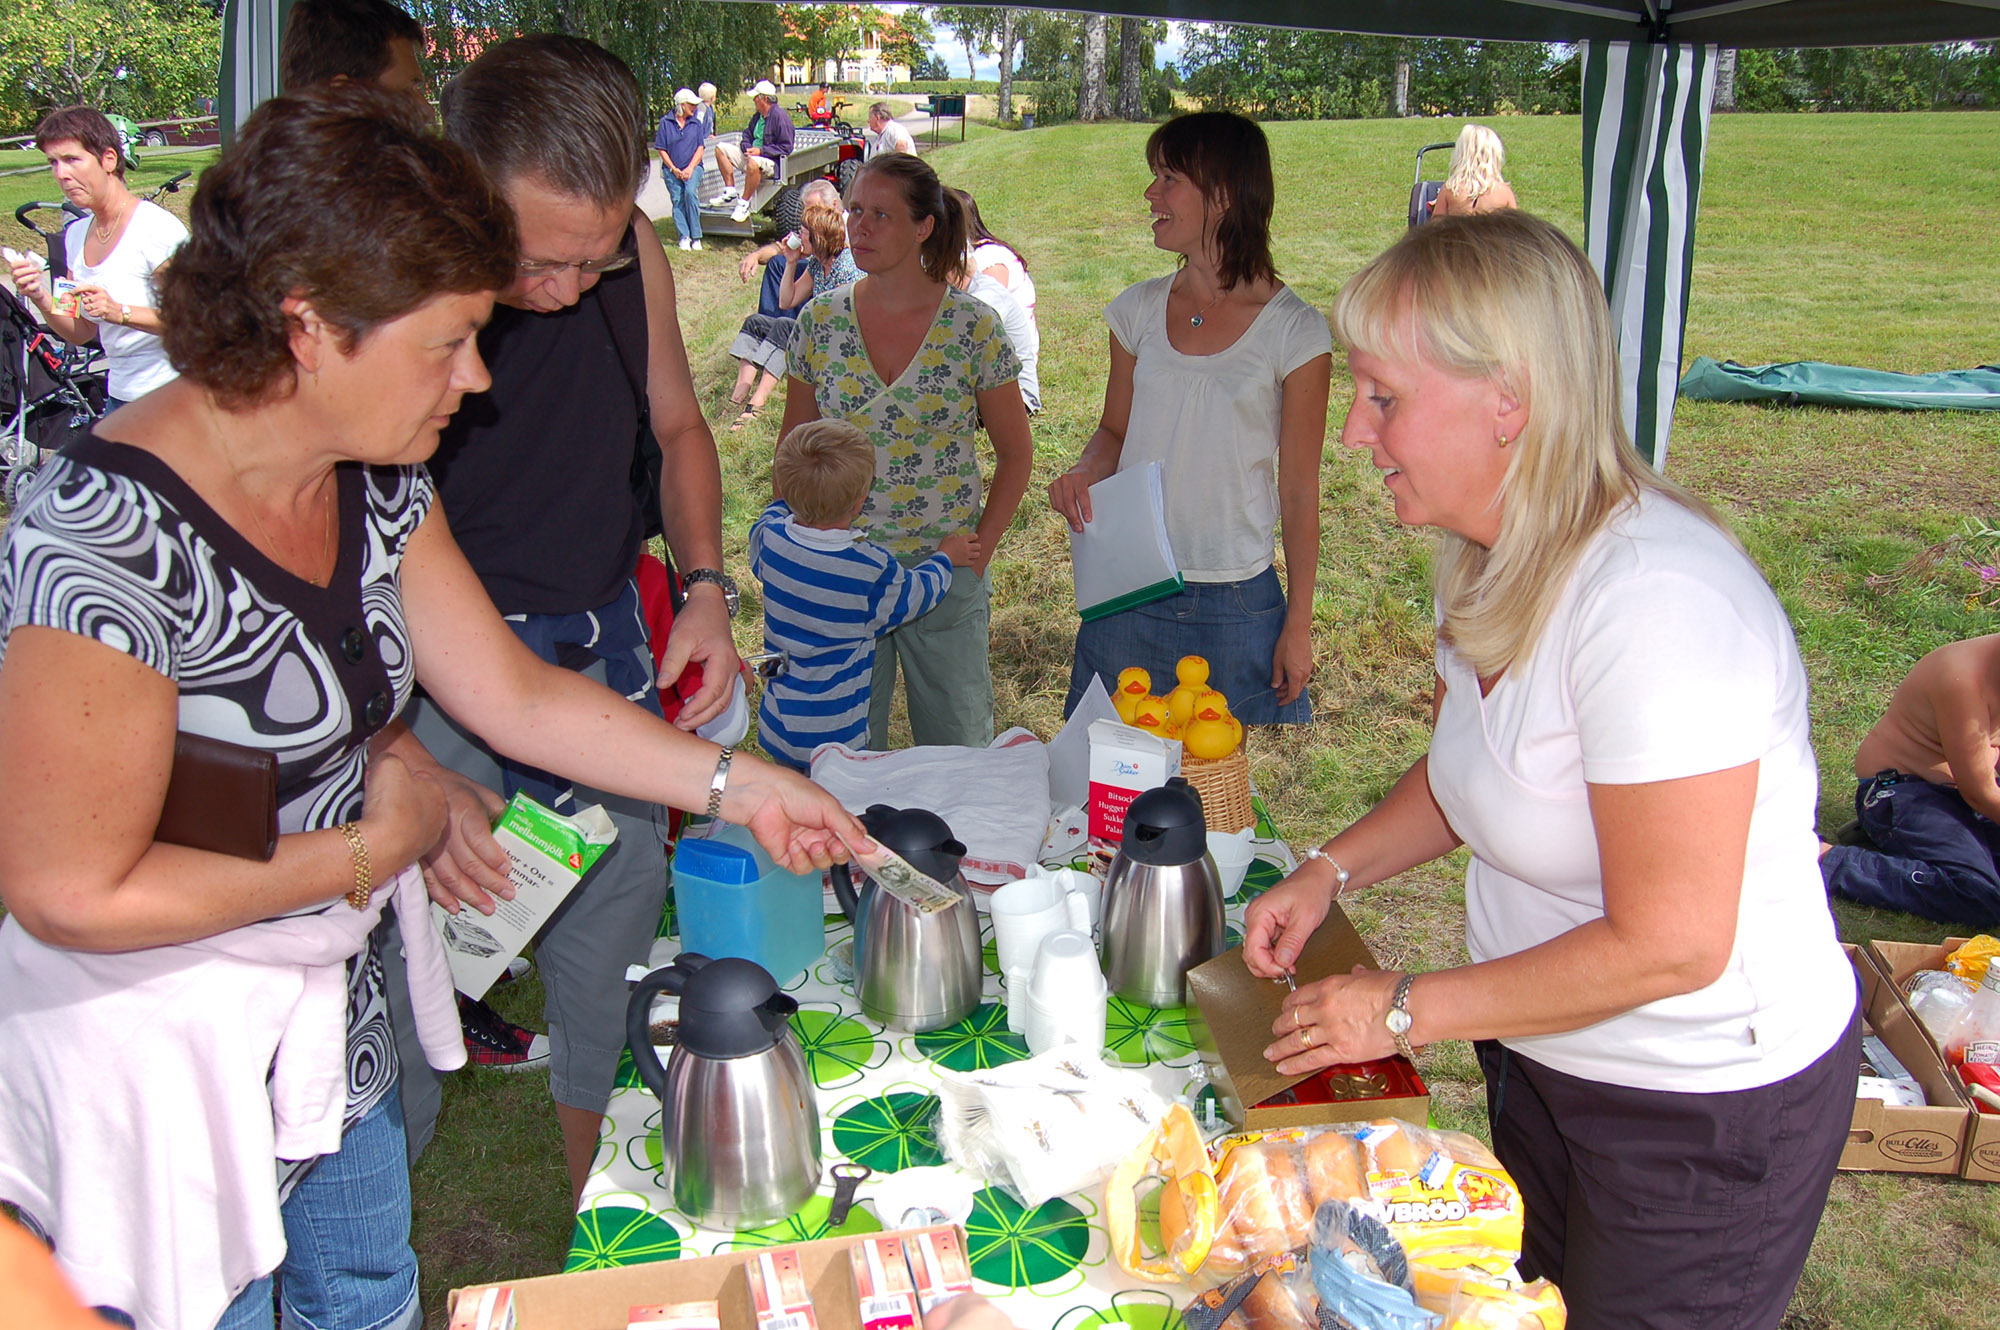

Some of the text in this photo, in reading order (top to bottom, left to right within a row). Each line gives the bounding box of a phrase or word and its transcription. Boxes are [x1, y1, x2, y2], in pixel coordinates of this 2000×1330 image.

[1108, 792, 1133, 803] Bitsock
[1098, 801, 1124, 813] Hugget
[1103, 813, 1124, 824] Sukke
[1105, 824, 1123, 834] Palas
[509, 820, 564, 859] mellanmjölk
[511, 867, 540, 888] mmar-
[530, 867, 546, 881] Ost
